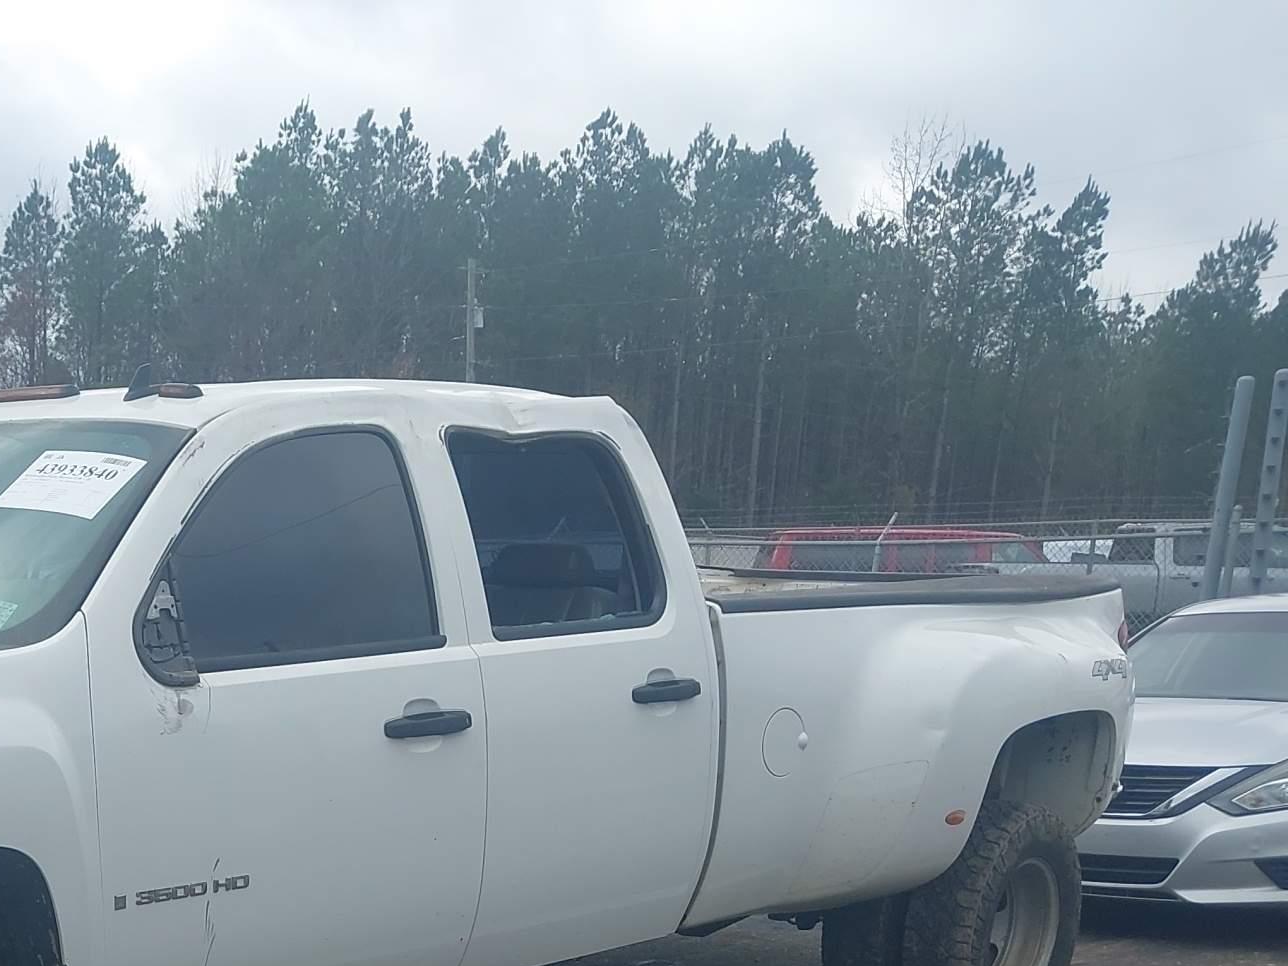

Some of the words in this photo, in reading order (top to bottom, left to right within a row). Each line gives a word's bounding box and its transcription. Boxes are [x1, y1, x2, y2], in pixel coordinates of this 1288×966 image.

[36, 463, 119, 481] 43933840
[136, 882, 208, 905] 3500
[213, 875, 250, 893] HD
